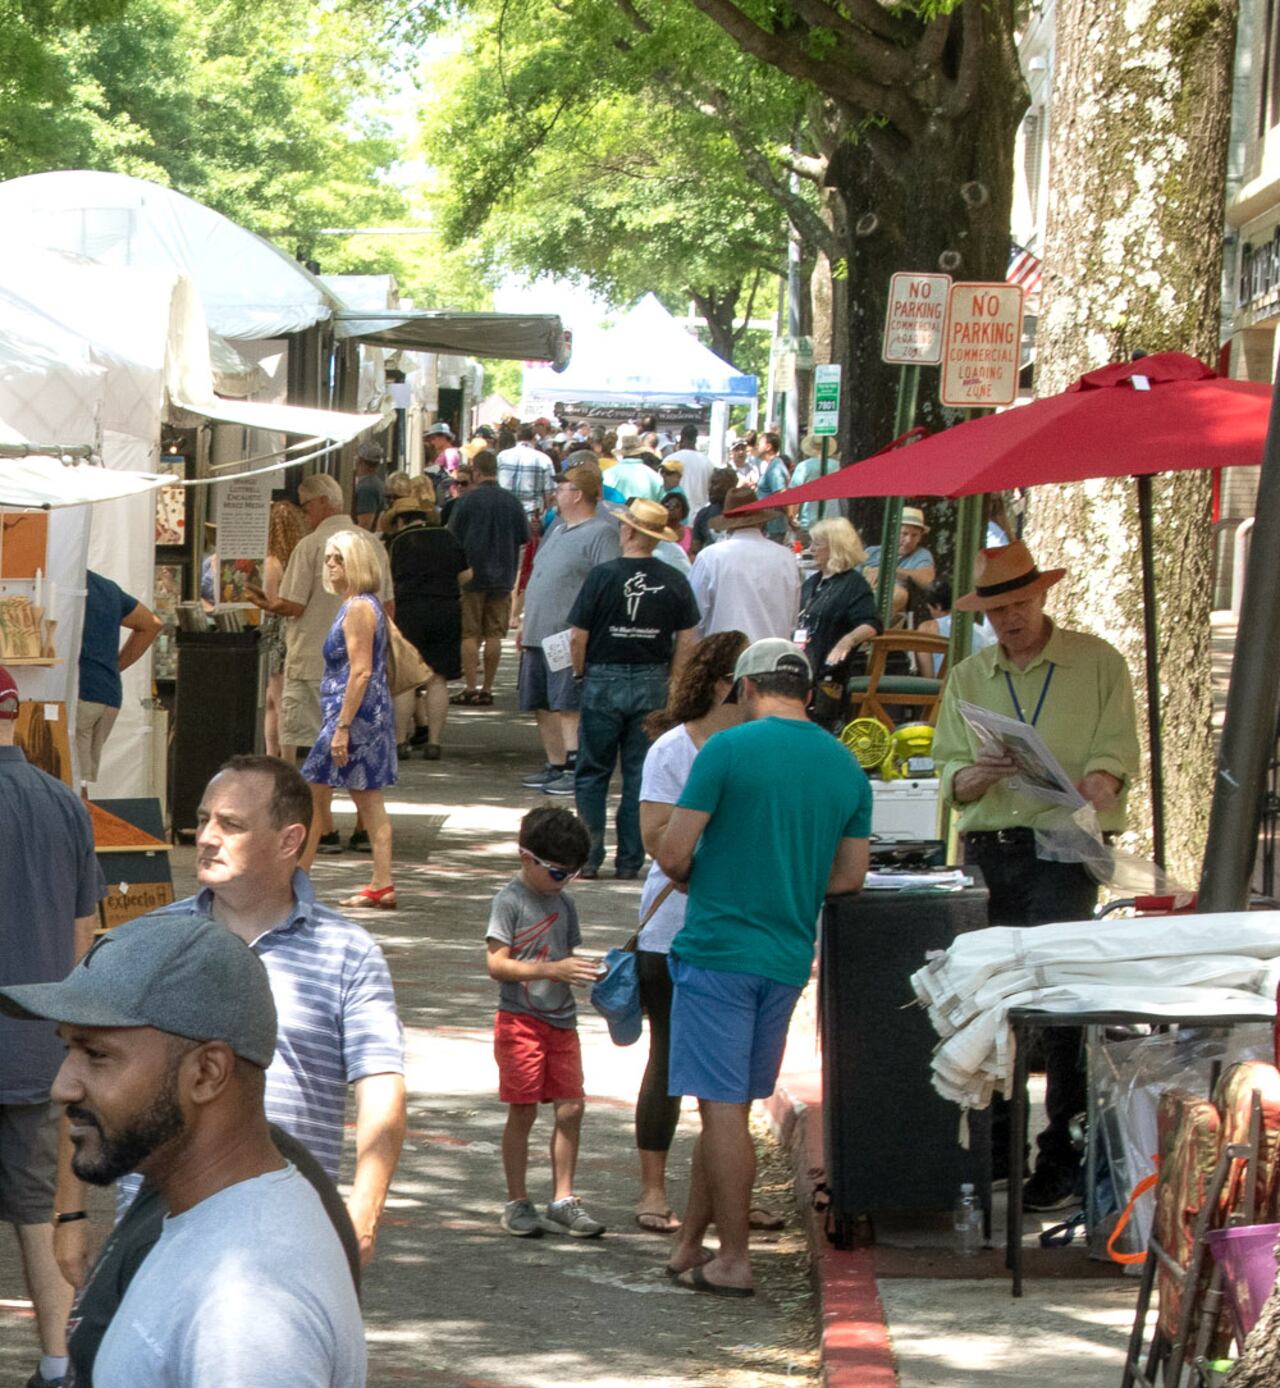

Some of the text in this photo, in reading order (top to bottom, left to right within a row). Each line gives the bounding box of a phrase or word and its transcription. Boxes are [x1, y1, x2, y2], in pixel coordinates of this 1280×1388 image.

[909, 281, 932, 299] NO
[894, 301, 942, 319] PARKING
[972, 294, 1000, 318] NO
[953, 322, 1015, 344] PARKING
[950, 348, 1014, 362] COMMERCIAL
[958, 366, 1003, 380] LOADING
[966, 383, 992, 397] ZONE
